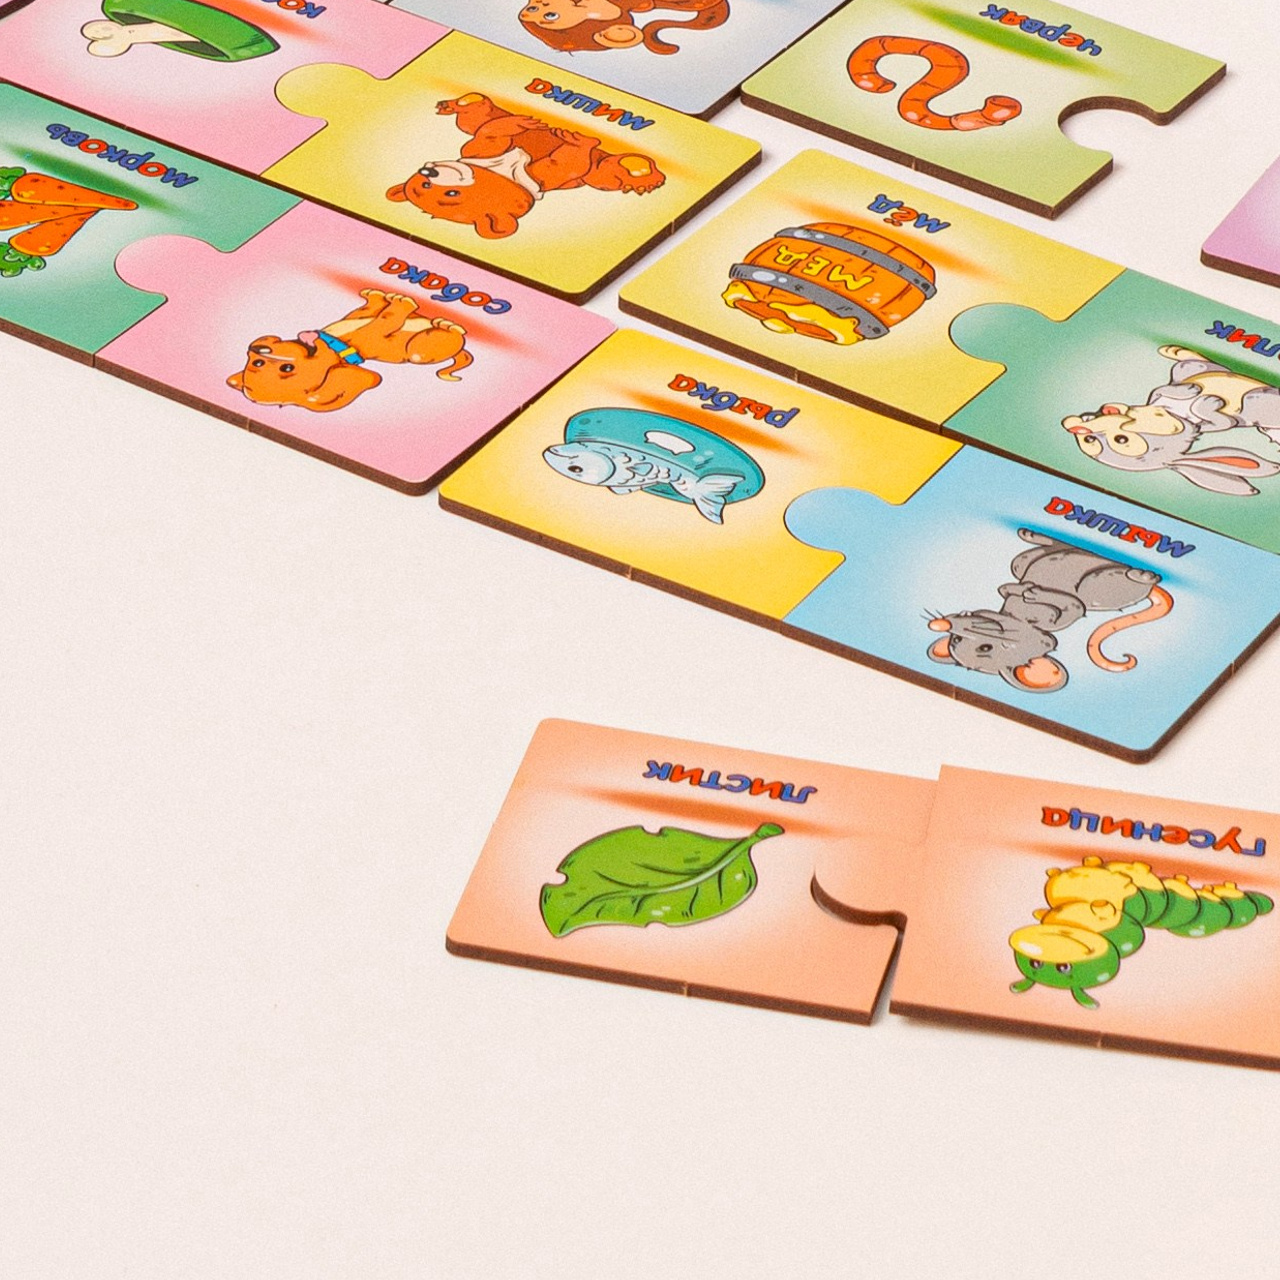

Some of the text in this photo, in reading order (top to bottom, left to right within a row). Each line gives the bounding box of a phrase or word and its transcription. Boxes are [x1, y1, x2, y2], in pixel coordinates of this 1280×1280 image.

[979, 3, 1102, 57] червяк
[525, 77, 655, 131] мишка
[46, 122, 199, 190] морковь
[867, 193, 950, 234] мёд
[379, 256, 512, 315] собака
[773, 244, 872, 292] МЕД
[667, 373, 800, 429] рыбка
[1043, 495, 1196, 559] мышка
[641, 758, 818, 806] листик
[1040, 804, 1267, 857] гусеница
